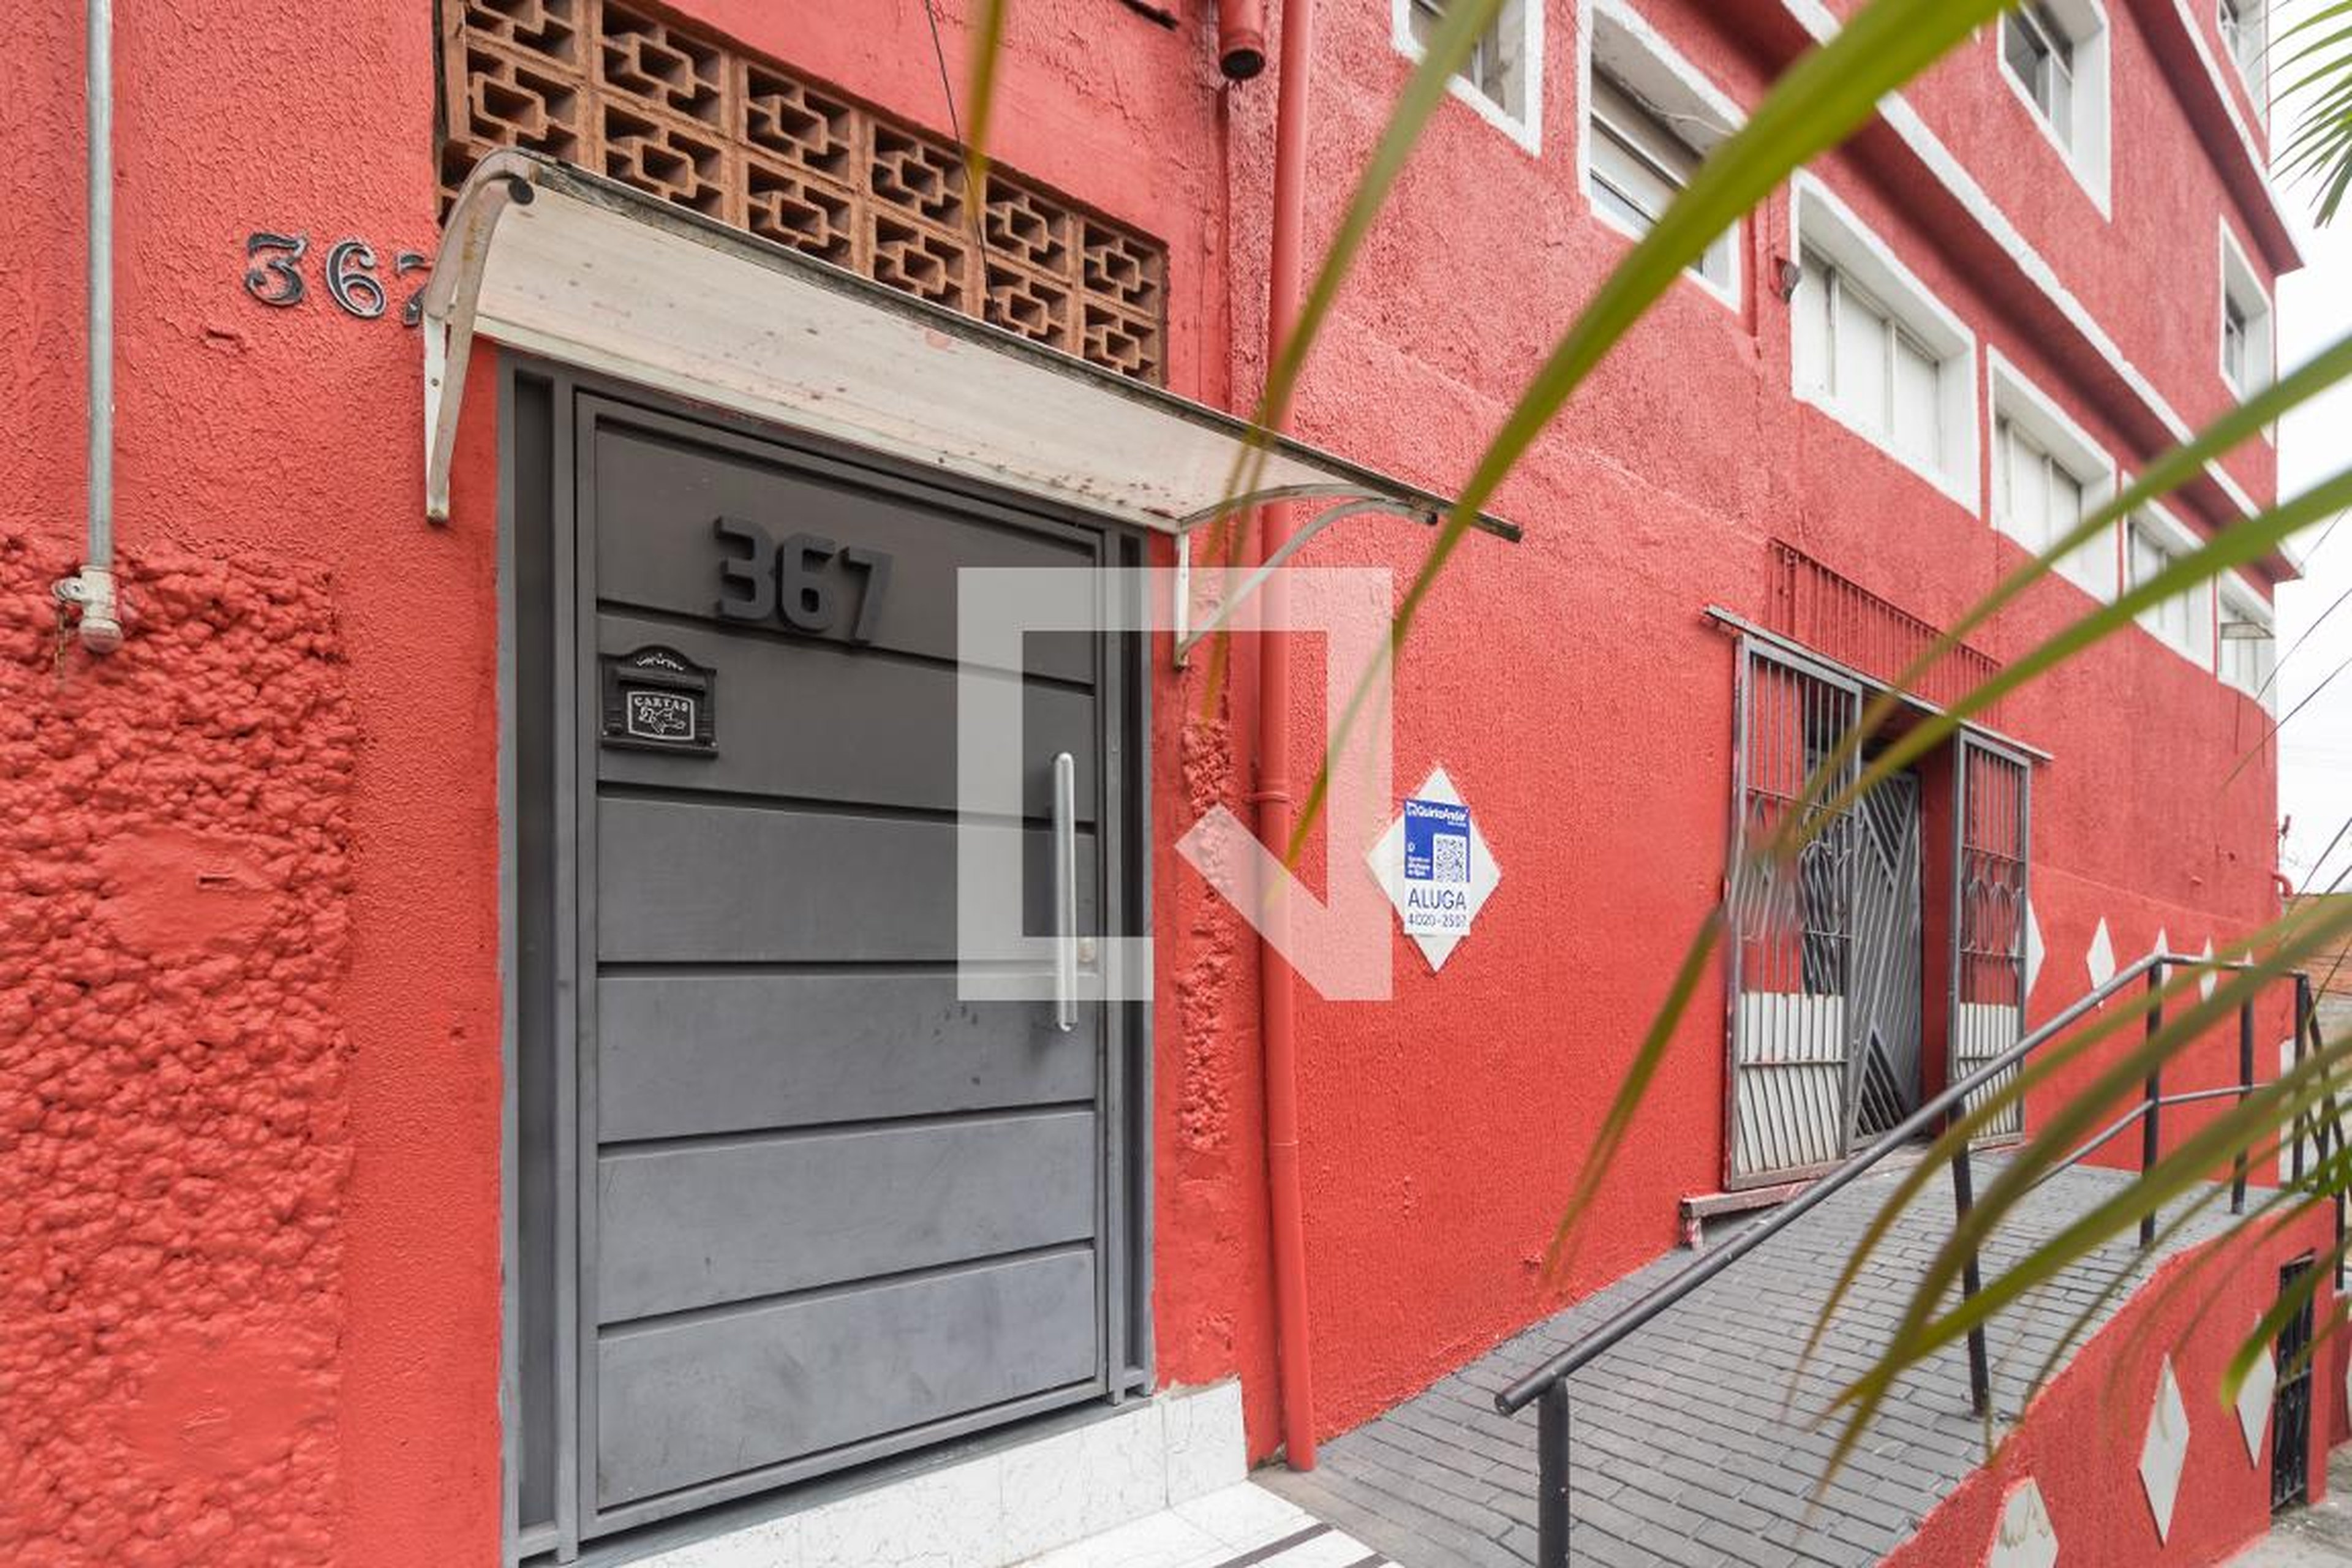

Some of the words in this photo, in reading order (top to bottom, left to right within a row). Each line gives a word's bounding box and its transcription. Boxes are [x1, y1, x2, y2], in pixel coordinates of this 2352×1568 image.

[714, 516, 893, 644] 367
[634, 696, 688, 712] CARTAS
[1408, 888, 1467, 911] ALUGA
